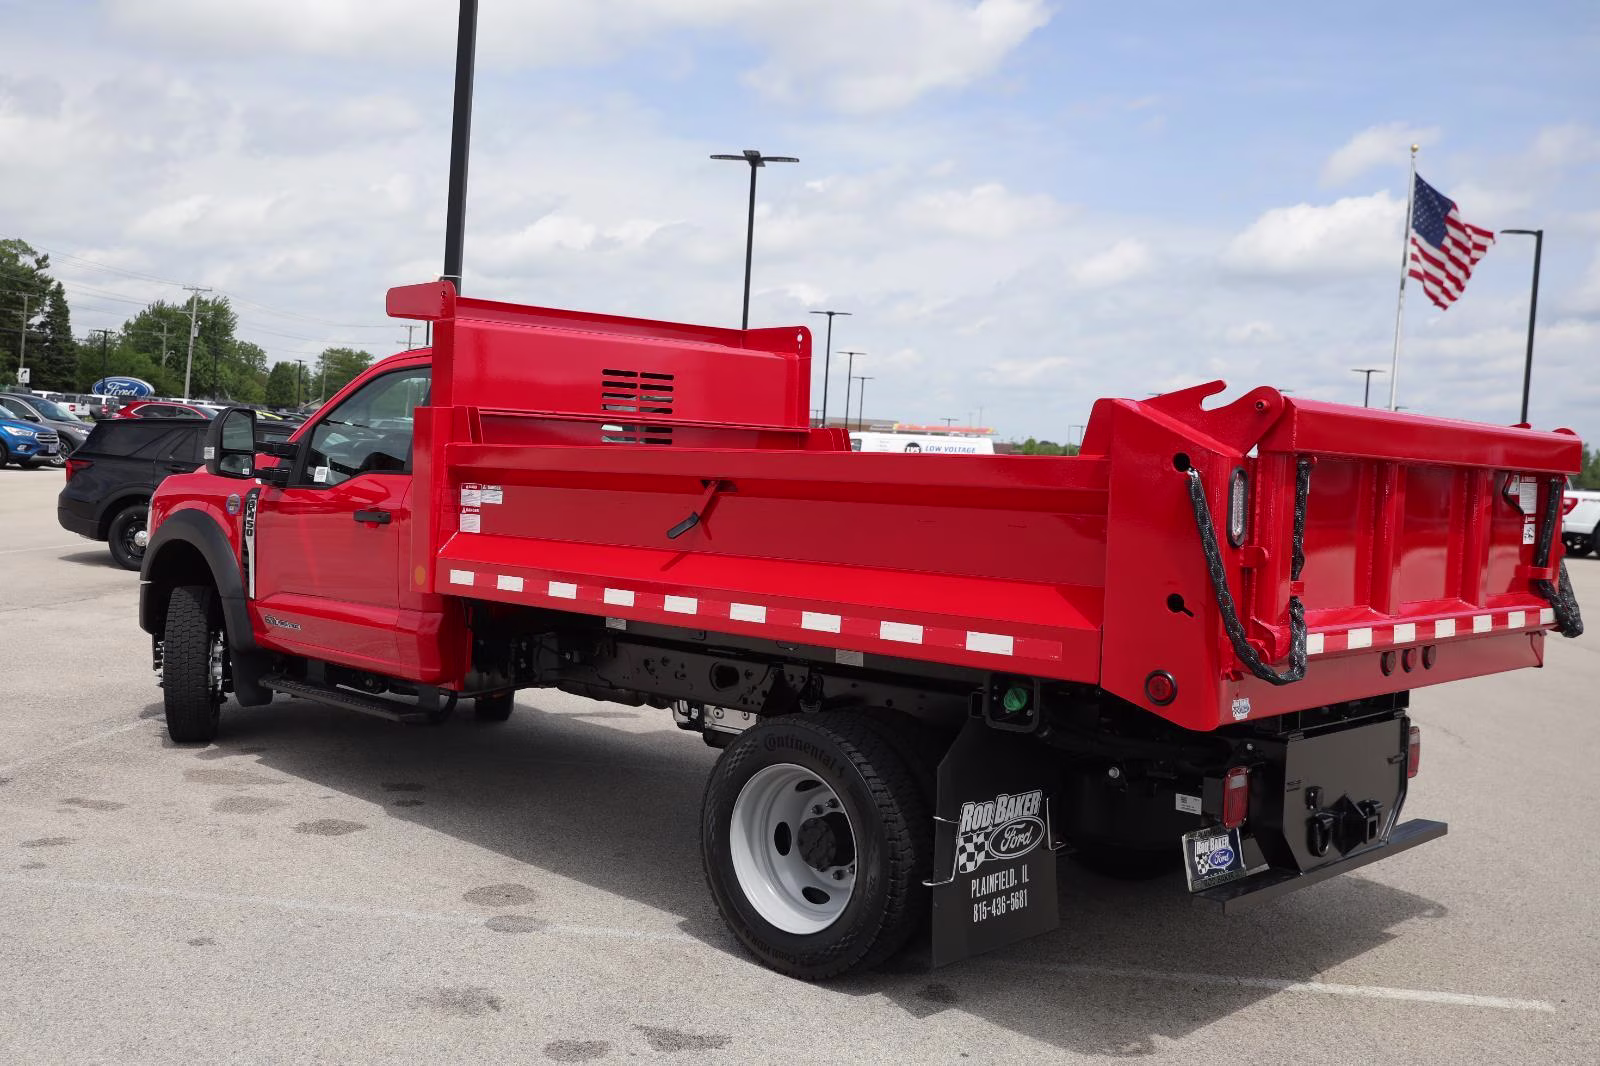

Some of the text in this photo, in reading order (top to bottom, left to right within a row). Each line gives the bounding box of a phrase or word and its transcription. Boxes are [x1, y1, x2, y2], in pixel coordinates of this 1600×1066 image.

[104, 382, 138, 396] Ford
[944, 446, 976, 454] VOLTAGE
[764, 733, 838, 771] Continental
[960, 791, 1041, 833] ROD BAKER
[1000, 823, 1034, 852] Ford
[1214, 851, 1230, 865] Ford
[971, 864, 1030, 898] PLAINFIELD, IL
[973, 889, 1028, 922] 815-436-5681
